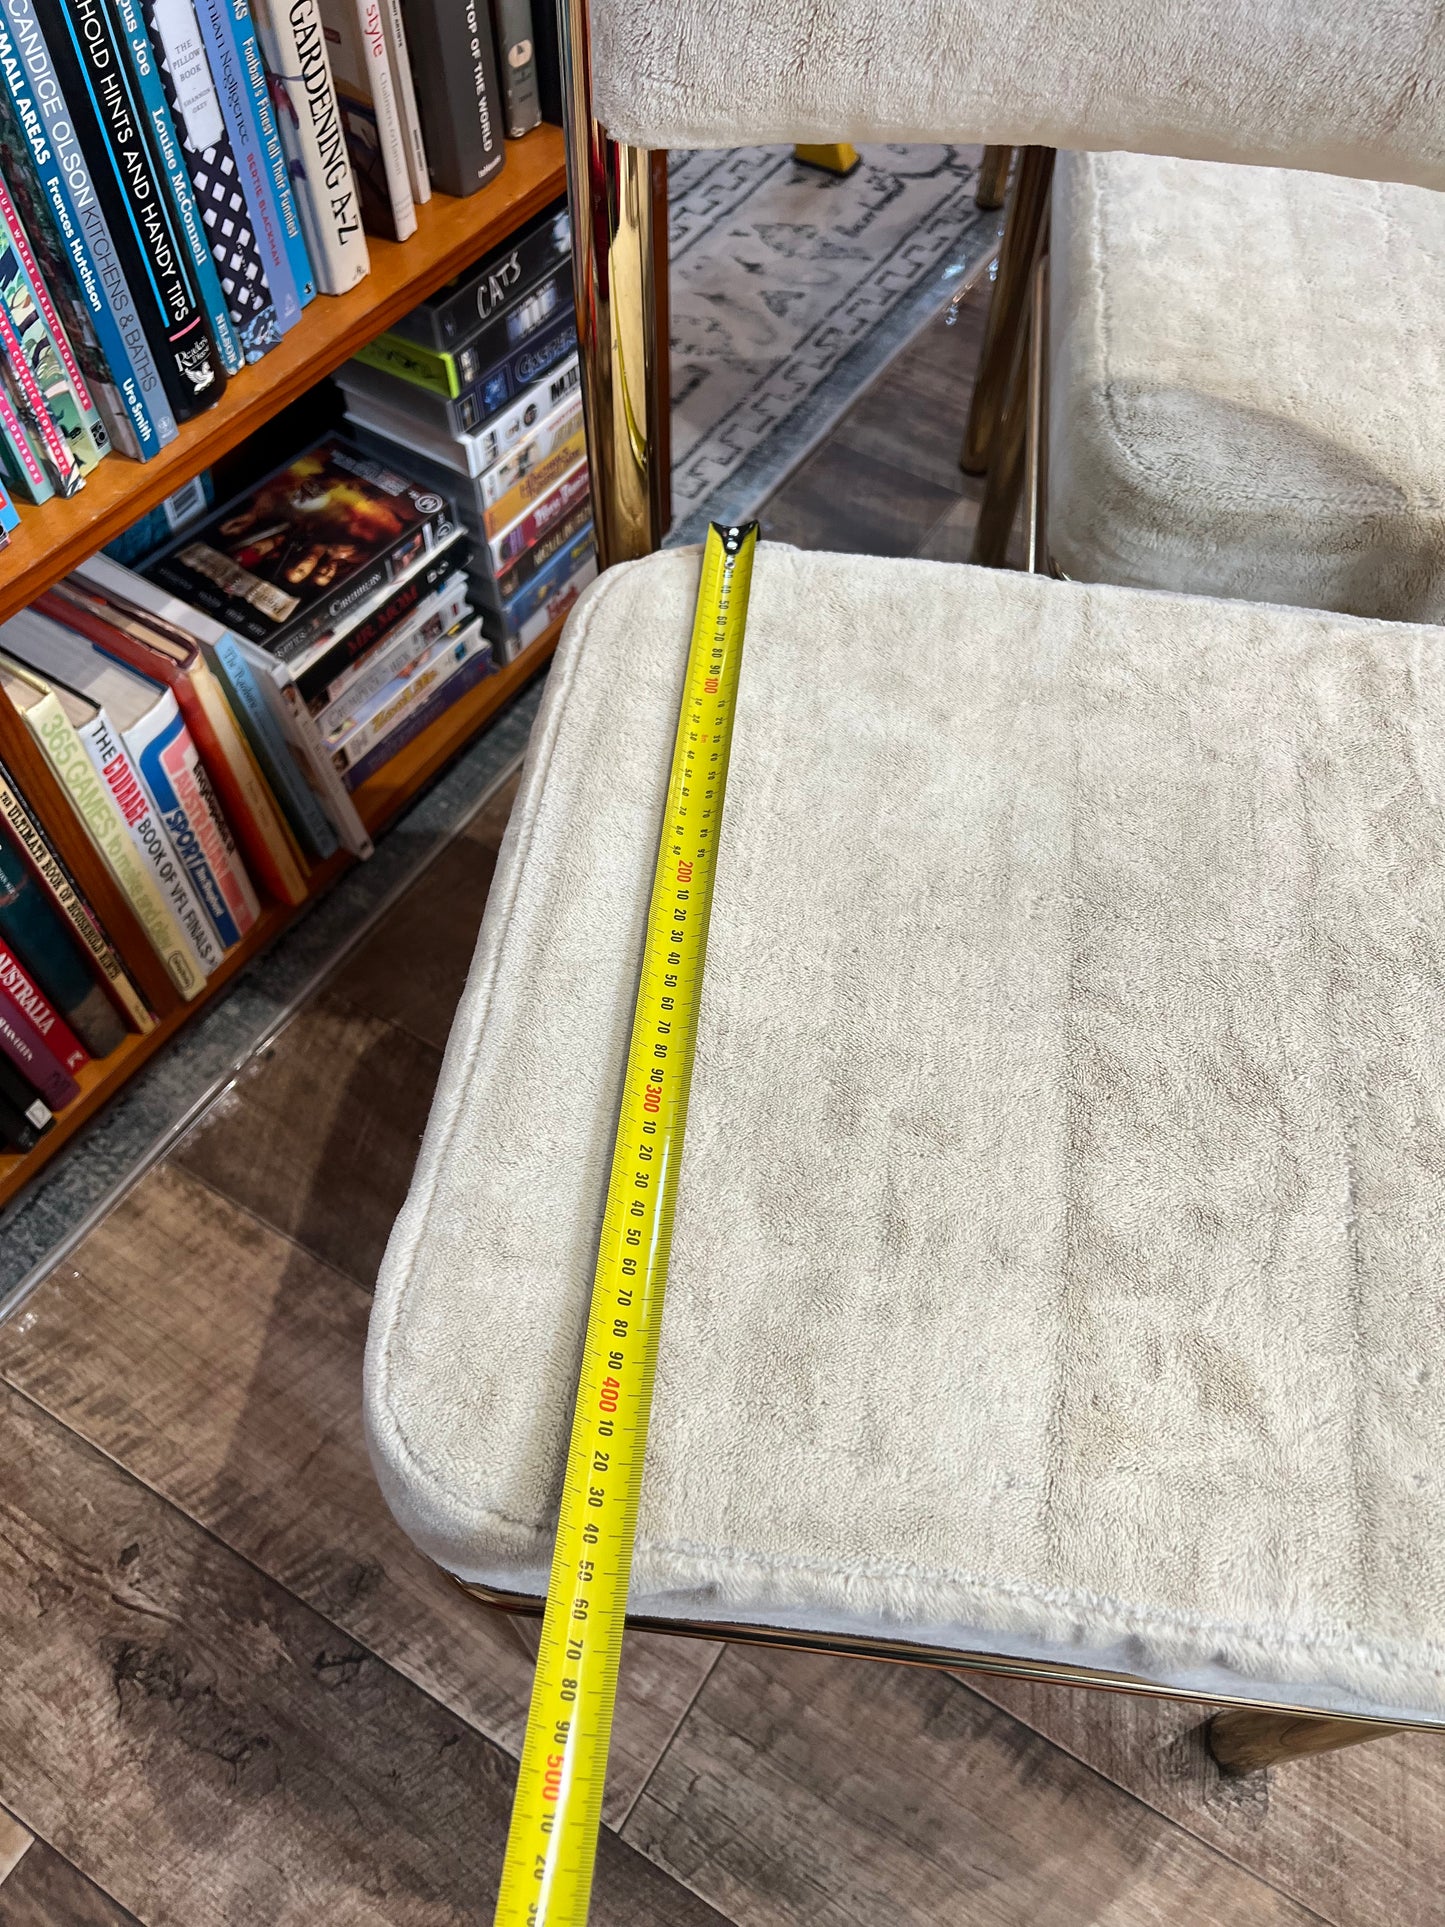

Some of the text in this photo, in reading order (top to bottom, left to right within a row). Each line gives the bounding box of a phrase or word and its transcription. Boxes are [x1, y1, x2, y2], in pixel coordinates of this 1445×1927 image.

[364, 4, 384, 58] style
[174, 39, 193, 55] THE
[470, 37, 481, 59] OF
[172, 48, 200, 70] PILLOW
[242, 36, 266, 98] Football's
[179, 64, 202, 82] BOOK
[472, 61, 487, 93] THE
[257, 96, 275, 136] Finest
[288, 0, 361, 247] GARDENING A-Z
[478, 96, 494, 153] WORLD
[266, 130, 283, 159] Tell
[75, 0, 189, 322] HOLD HINTS AND HANDY TIPS
[220, 49, 249, 146] Negligence
[246, 152, 263, 198] BERTIE
[257, 199, 281, 267] BLACKMAN
[271, 155, 290, 190] Their
[8, 0, 157, 393] CANDICE OLSON KITCHENS & BATHS
[132, 37, 151, 77] Joe
[151, 106, 176, 171] Louise
[172, 170, 208, 267] McConnell
[214, 312, 237, 364] NELSON
[278, 186, 299, 239] Funniest
[16, 98, 51, 166] AREAS
[47, 177, 74, 238] Frances
[70, 238, 102, 312] Hutchison
[123, 377, 137, 405] Ure
[131, 401, 153, 442] Smith
[477, 252, 521, 319] CATS
[13, 228, 36, 275] WORKS
[34, 281, 60, 332] CLASSIC
[57, 337, 89, 411] STORYBOOK
[12, 350, 38, 399] CLASSIC
[36, 405, 68, 471] STORYBOOK
[3, 409, 40, 480] STORYBOOK
[718, 600, 729, 610] 50
[716, 616, 727, 626] 60
[714, 632, 725, 642] 70
[711, 648, 723, 658] 80
[709, 665, 721, 675] 90
[704, 677, 718, 694] 100
[40, 712, 75, 766] 365
[65, 763, 117, 839] GAMES
[107, 834, 123, 856] to
[117, 855, 144, 898] make
[136, 894, 163, 924] and
[91, 720, 213, 960] THE COURAGE BOOK OF VFL FINALS
[166, 809, 206, 870] SPORT
[7, 802, 46, 866] ULTIMATE
[42, 854, 64, 892] BOOK
[59, 885, 74, 903] OF
[676, 860, 694, 883] 200
[676, 888, 689, 900] 10
[673, 908, 687, 921] 20
[670, 929, 683, 943] 30
[667, 951, 681, 965] 40
[663, 973, 677, 988] 50
[660, 996, 675, 1011] 60
[657, 1020, 671, 1034] 70
[653, 1043, 668, 1058] 80
[650, 1068, 665, 1083] 90
[643, 1084, 663, 1113] 300
[642, 1120, 657, 1134] 10
[638, 1144, 654, 1161] 20
[634, 1172, 650, 1189] 30
[629, 1200, 646, 1217] 40
[625, 1228, 642, 1246] 50
[621, 1257, 638, 1276] 60
[617, 1289, 633, 1307] 70
[612, 1318, 629, 1338] 80
[607, 1350, 624, 1370] 90
[598, 1376, 621, 1413] 400
[597, 1419, 614, 1437] 10
[592, 1451, 610, 1472] 20
[587, 1487, 606, 1508] 30
[582, 1523, 600, 1545] 40
[576, 1560, 595, 1583] 50
[571, 1598, 590, 1622] 60
[566, 1639, 584, 1661] 70
[560, 1678, 578, 1702] 80
[553, 1720, 571, 1744] 90
[542, 1753, 565, 1802] 500
